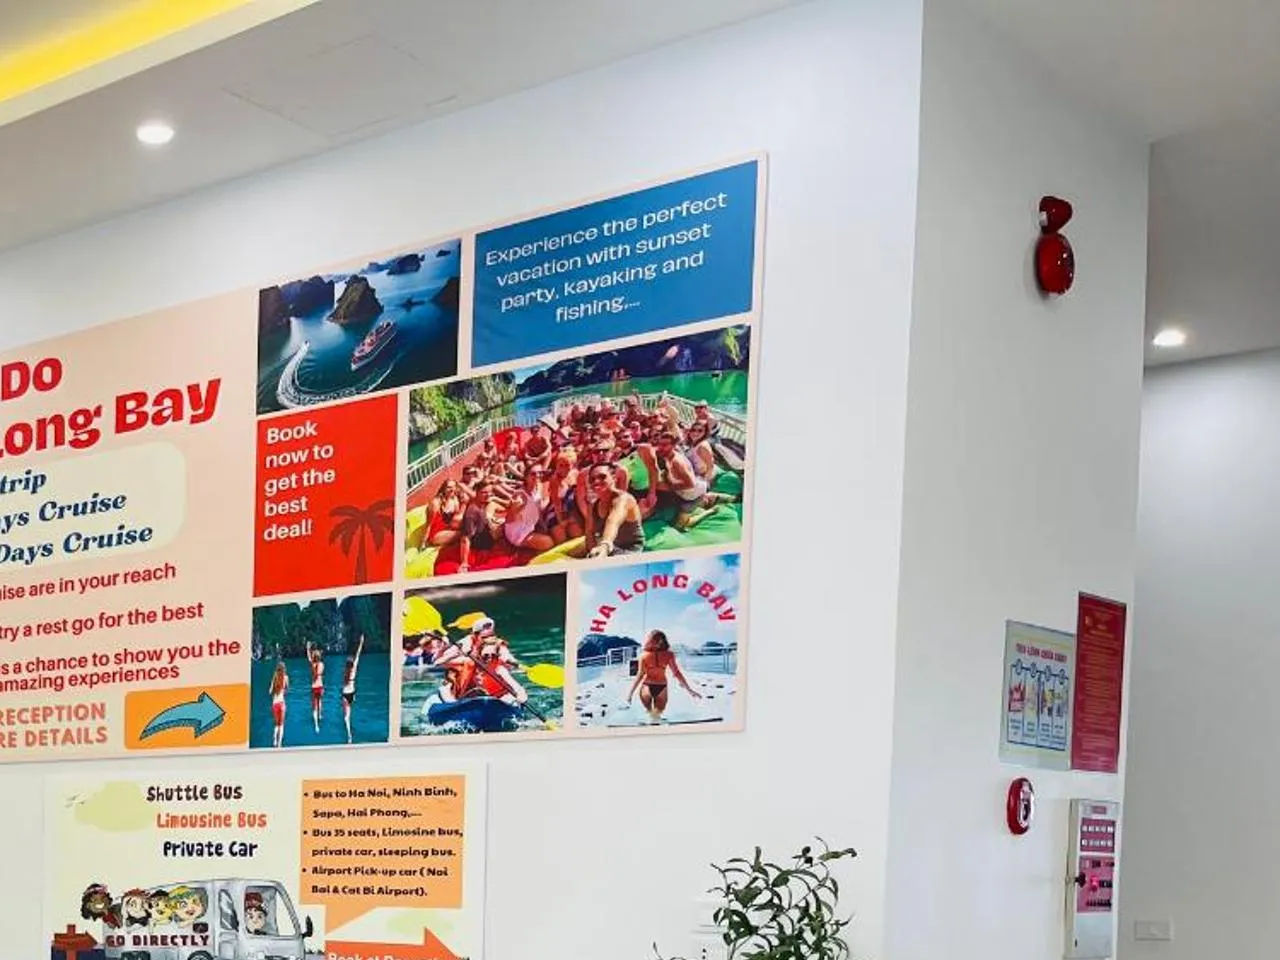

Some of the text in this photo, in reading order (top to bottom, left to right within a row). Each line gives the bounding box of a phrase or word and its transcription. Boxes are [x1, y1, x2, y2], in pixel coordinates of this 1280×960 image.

[485, 191, 728, 267] Experience the perfect
[496, 223, 712, 287] vacation with sunset
[501, 250, 705, 313] party, kayaking and
[0, 357, 63, 401] Do
[114, 378, 221, 434] Bay
[267, 420, 318, 445] Book
[265, 444, 334, 469] now to
[0, 469, 47, 495] trip
[264, 467, 336, 497] get the
[38, 492, 127, 522] Cruise
[264, 496, 308, 517] best
[63, 525, 153, 553] Cruise
[263, 519, 313, 541] deal!
[29, 580, 56, 597] are
[59, 571, 75, 593] in
[79, 573, 120, 597] your
[123, 563, 176, 586] reach
[589, 573, 736, 634] HA LONG BAY
[23, 622, 32, 637] a
[36, 619, 68, 636] rest
[72, 616, 95, 635] go
[98, 608, 124, 629] for
[127, 607, 158, 624] the
[161, 602, 204, 621] best
[12, 662, 21, 674] a
[24, 650, 88, 672] chance
[92, 651, 110, 666] to
[113, 646, 163, 666] show
[167, 644, 203, 667] you
[208, 638, 241, 656] the
[68, 664, 180, 688] experiences
[24, 726, 108, 748] DETAILS
[146, 784, 243, 802] Shuttle Bus
[313, 789, 333, 799] Bus
[335, 789, 347, 798] to
[348, 789, 365, 798] Ha
[392, 787, 422, 797] Ninh
[157, 811, 267, 829] Limousine Bus
[347, 808, 368, 817] Hai
[312, 829, 332, 837] Bus
[163, 840, 258, 857] Private Car
[311, 847, 456, 859] private car, sleeping bus.
[311, 866, 352, 877] Airport
[353, 866, 397, 877] Pick-up
[399, 868, 418, 876] car
[311, 885, 331, 894] Bai
[341, 886, 361, 895] Cat
[363, 886, 375, 895] Bi
[105, 934, 209, 947] GO DIRECTLY
